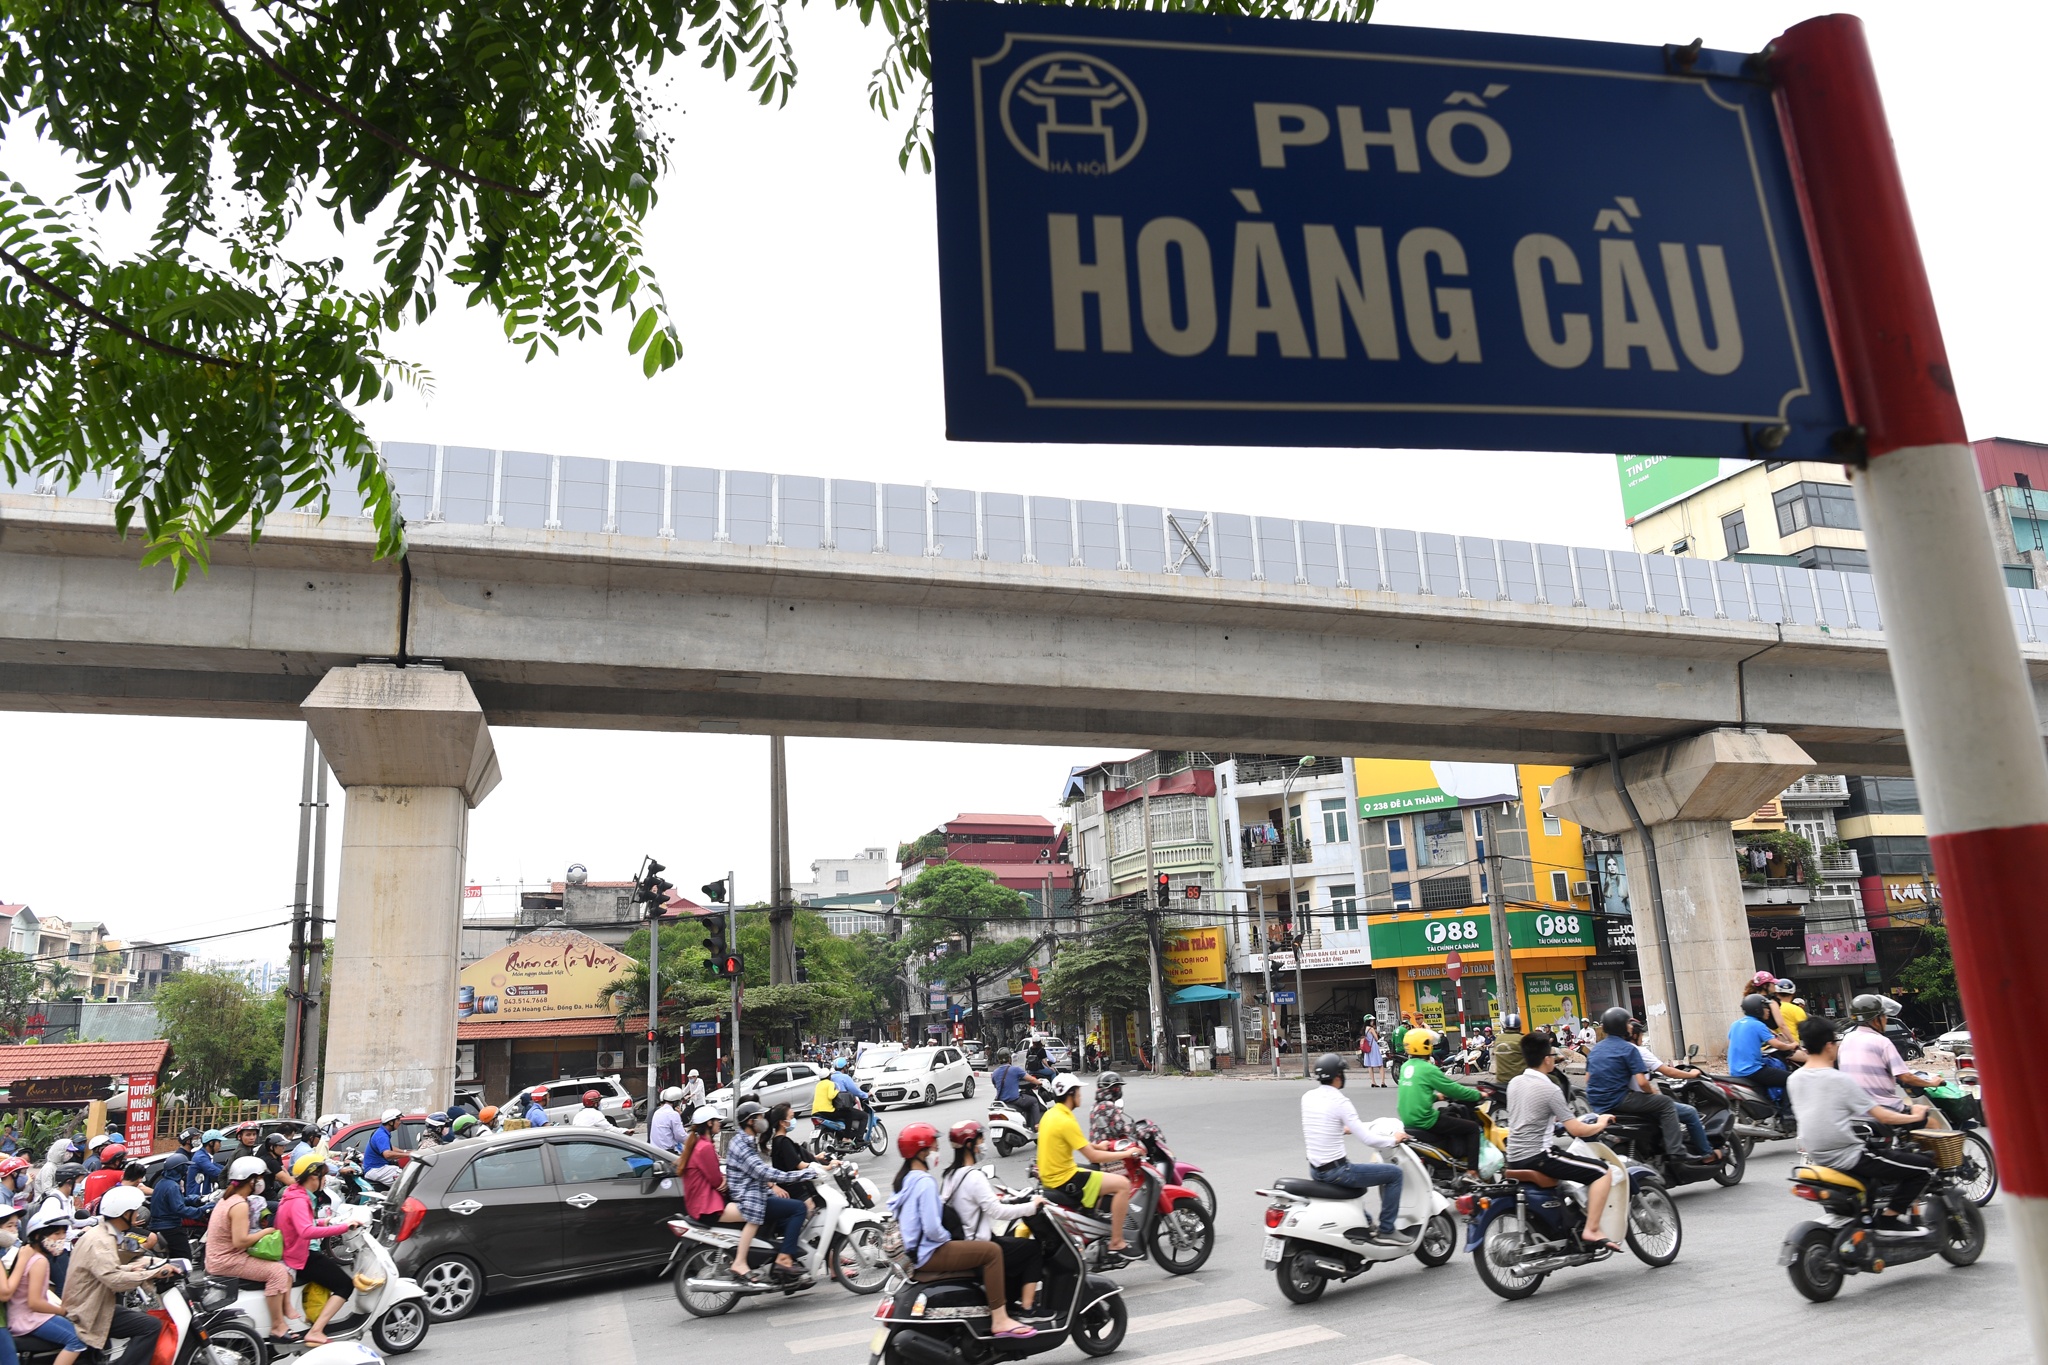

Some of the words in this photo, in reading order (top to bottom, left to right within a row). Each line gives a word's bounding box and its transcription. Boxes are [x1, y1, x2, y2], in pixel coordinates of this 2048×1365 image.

[1253, 84, 1512, 178] PHỐ
[1077, 158, 1107, 177] NỘI
[1047, 188, 1482, 364] HOÀNG
[1512, 196, 1743, 375] CẦU
[1639, 474, 1649, 483] NAM
[1373, 802, 1388, 811] 238
[1390, 798, 1401, 809] ĐÊ
[1402, 799, 1413, 808] LA
[1414, 795, 1444, 806] THÀNH
[1425, 920, 1478, 944] F88
[1536, 914, 1580, 937] F88
[583, 948, 620, 973] Vọng
[1182, 957, 1195, 965] LOẠI
[1407, 968, 1416, 979] HỆ
[1417, 966, 1440, 978] THỐNG
[1555, 982, 1575, 992] F88
[522, 1005, 541, 1013] Hoàng
[130, 1081, 155, 1096] TUYỂN
[130, 1096, 153, 1109] NHÂN
[132, 1109, 150, 1122] VIÊN
